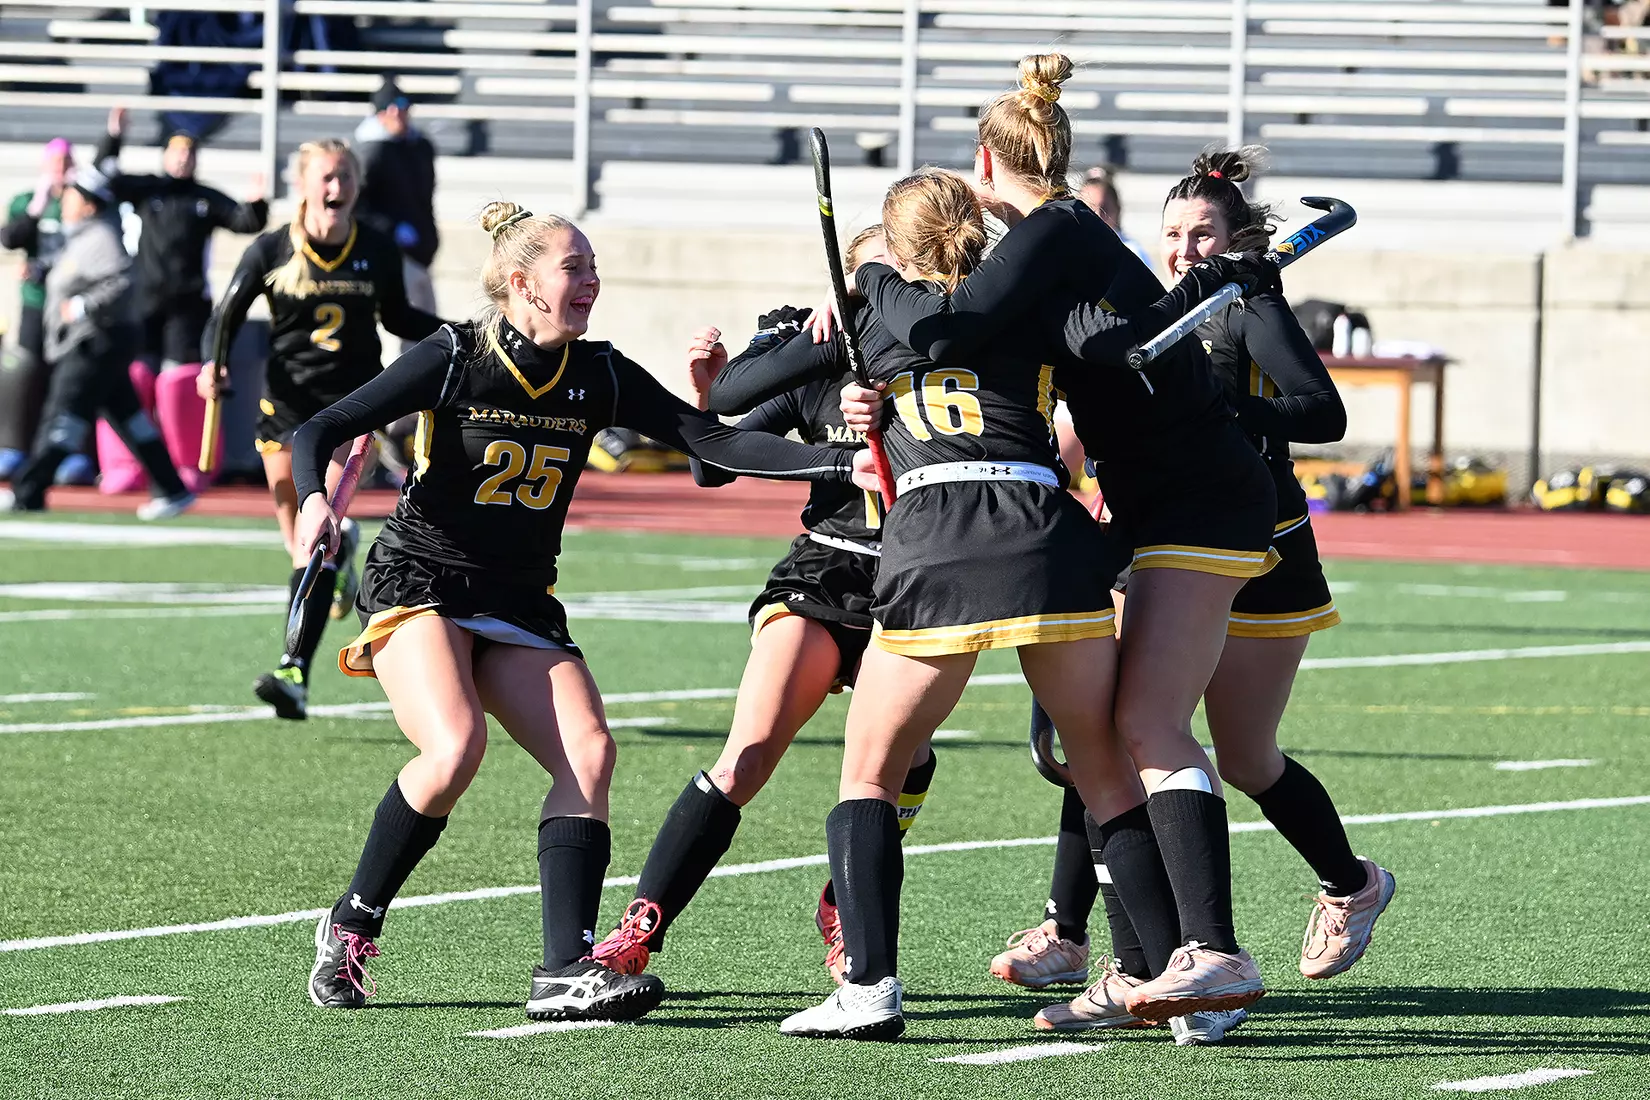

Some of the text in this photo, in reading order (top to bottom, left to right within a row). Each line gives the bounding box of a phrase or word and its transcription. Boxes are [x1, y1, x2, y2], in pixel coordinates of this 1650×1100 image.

[310, 303, 345, 352] 2
[468, 406, 588, 435] MARAUDERS
[883, 367, 985, 442] 16
[474, 439, 571, 510] 25
